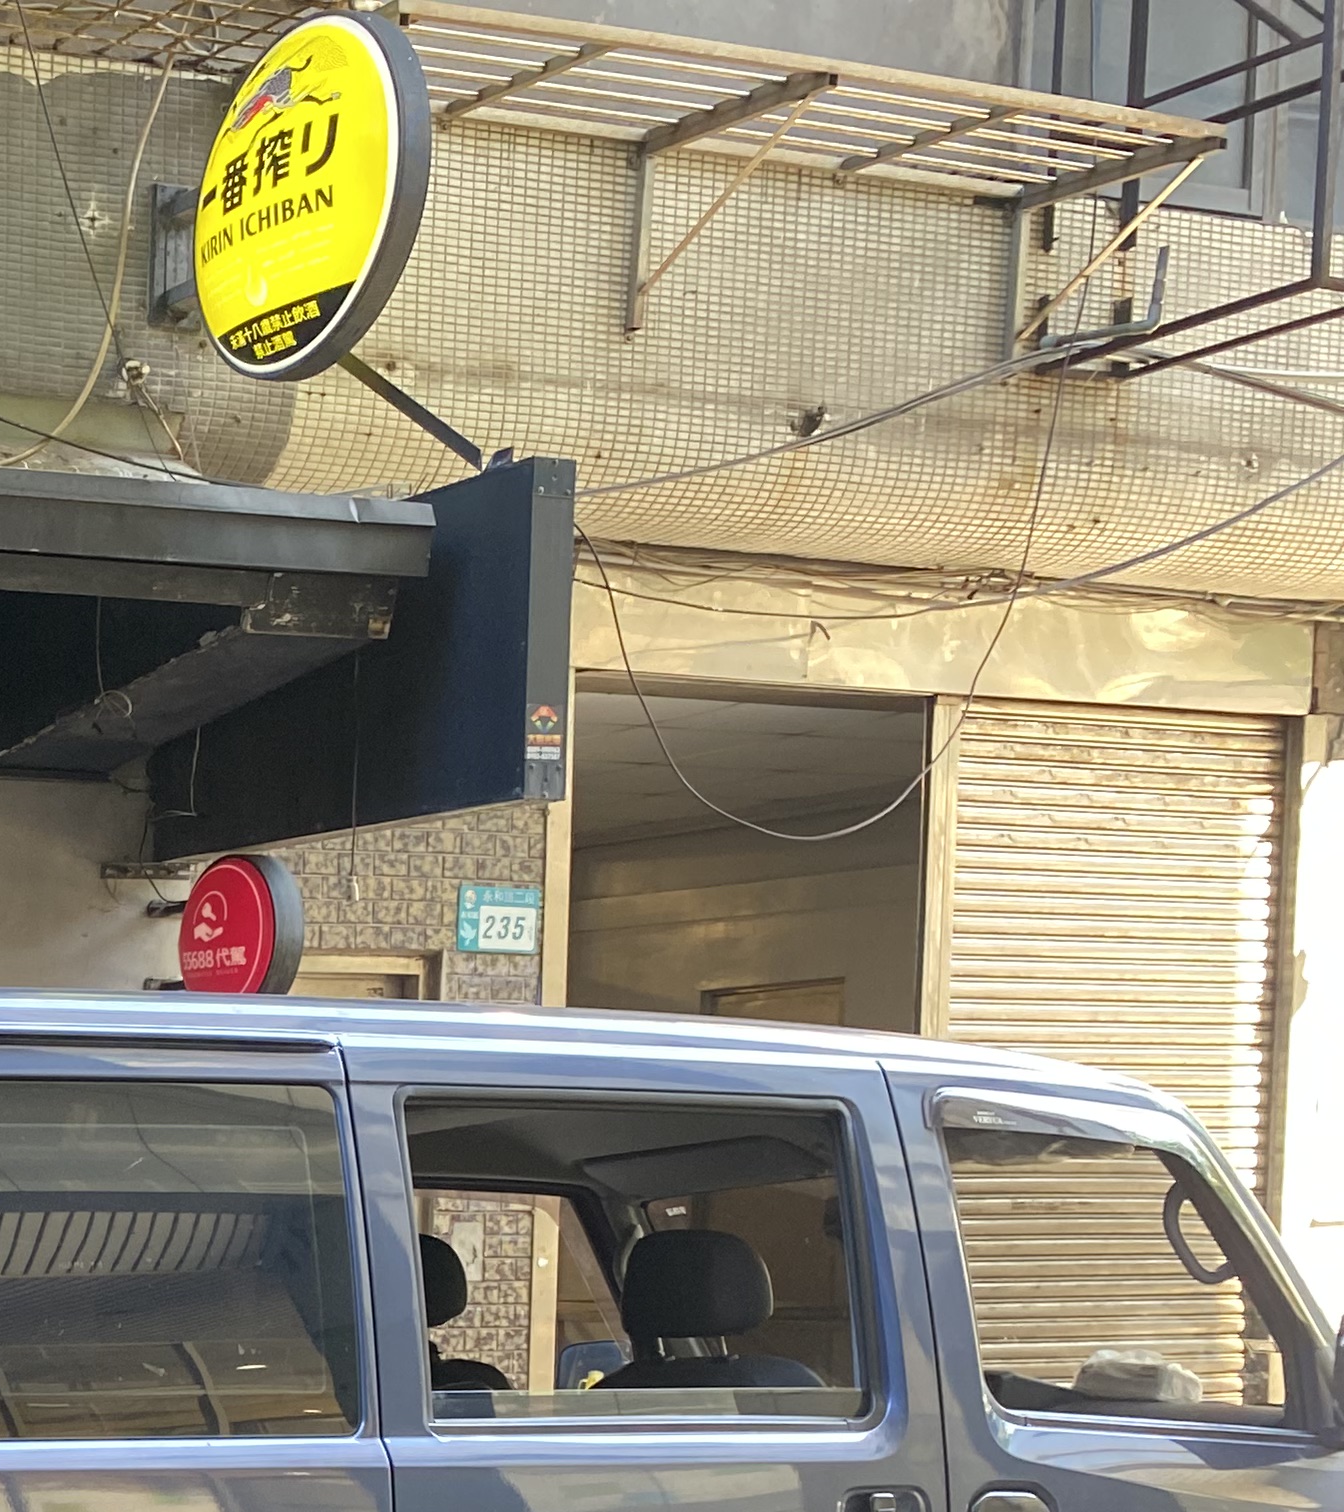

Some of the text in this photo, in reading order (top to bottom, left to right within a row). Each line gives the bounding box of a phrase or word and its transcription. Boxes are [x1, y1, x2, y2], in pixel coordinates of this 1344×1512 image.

[201, 112, 339, 216] 一番搾り
[200, 223, 234, 268] KIRIN
[240, 184, 334, 242] ICHIBAN
[482, 915, 526, 941] 235
